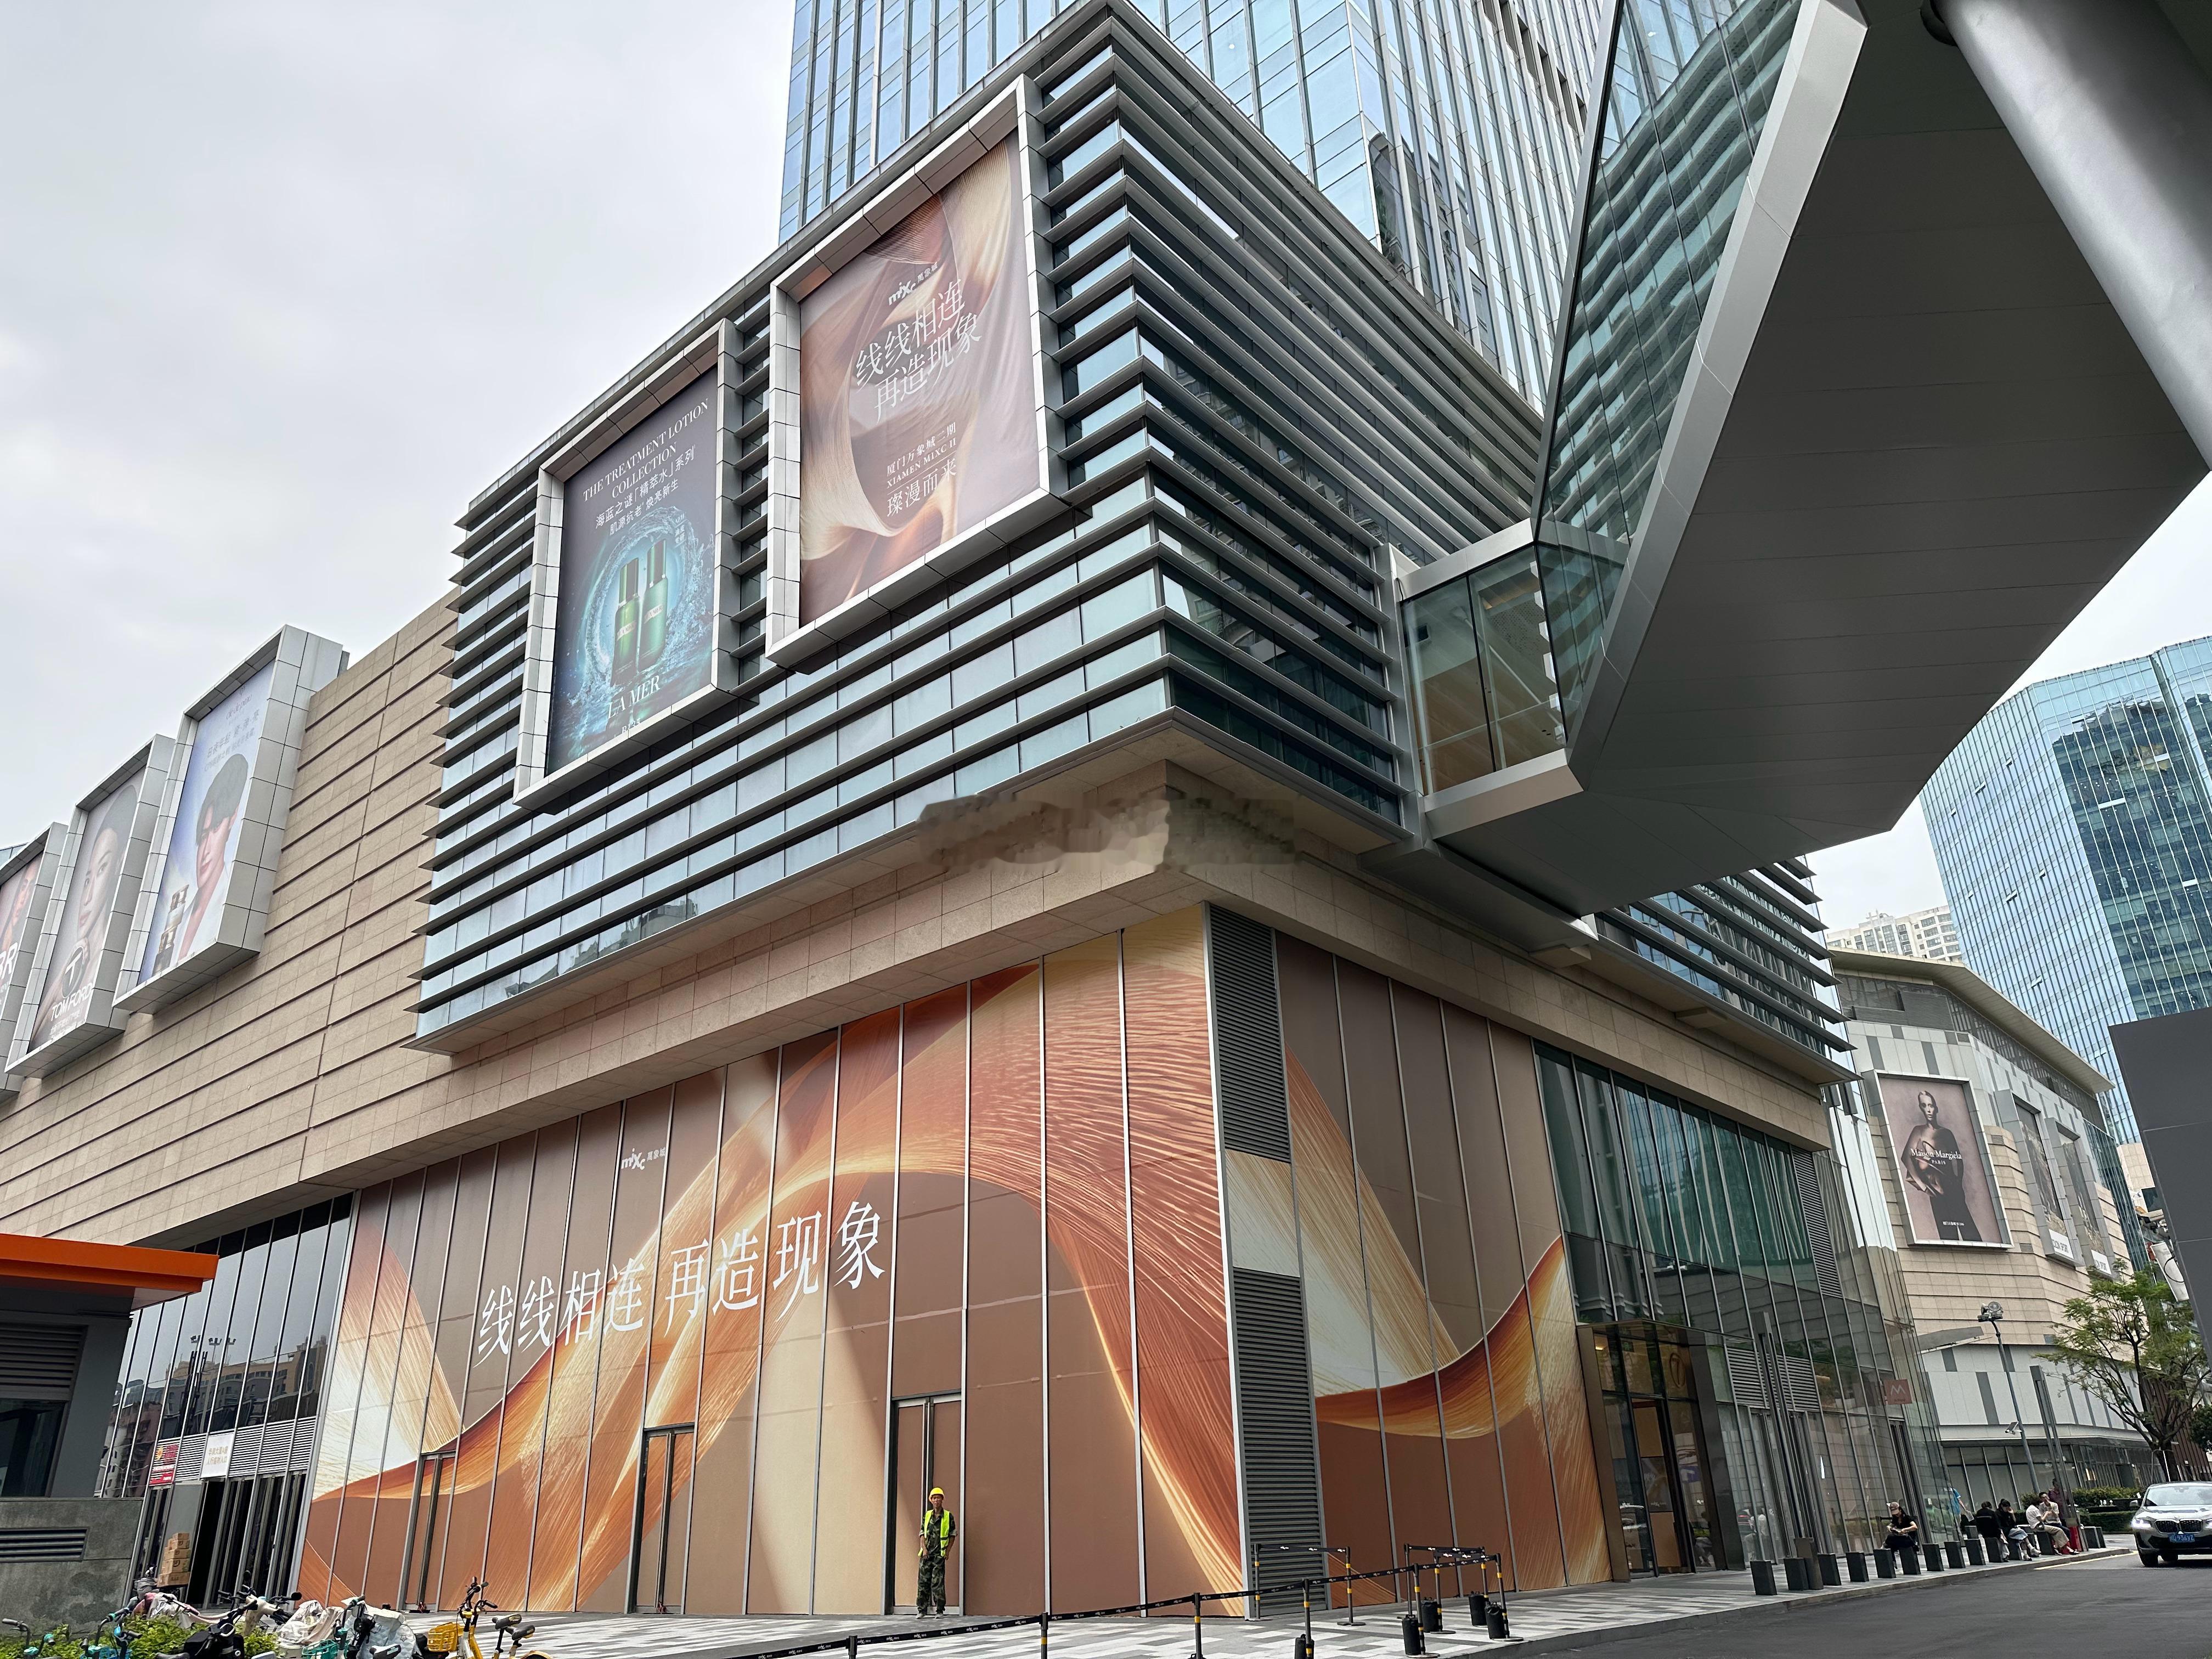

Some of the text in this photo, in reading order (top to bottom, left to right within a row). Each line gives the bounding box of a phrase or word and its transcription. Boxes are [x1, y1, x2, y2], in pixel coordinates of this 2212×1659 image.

[856, 279, 965, 393] 线线相连
[874, 312, 982, 424] 再造现象
[583, 398, 708, 502] THE TREATMENT LOTION
[612, 442, 677, 498] COLLECTION
[887, 422, 956, 477] 厦门万象城二期
[887, 438, 956, 489] XIAMEN MIXC II
[887, 459, 956, 517] 璨漫而来
[608, 675, 661, 719] LA MER
[51, 982, 93, 1022] TOM FORD
[1910, 1148, 1962, 1160] Maison Margiela
[474, 1201, 885, 1368] 线线相连 再造现象
